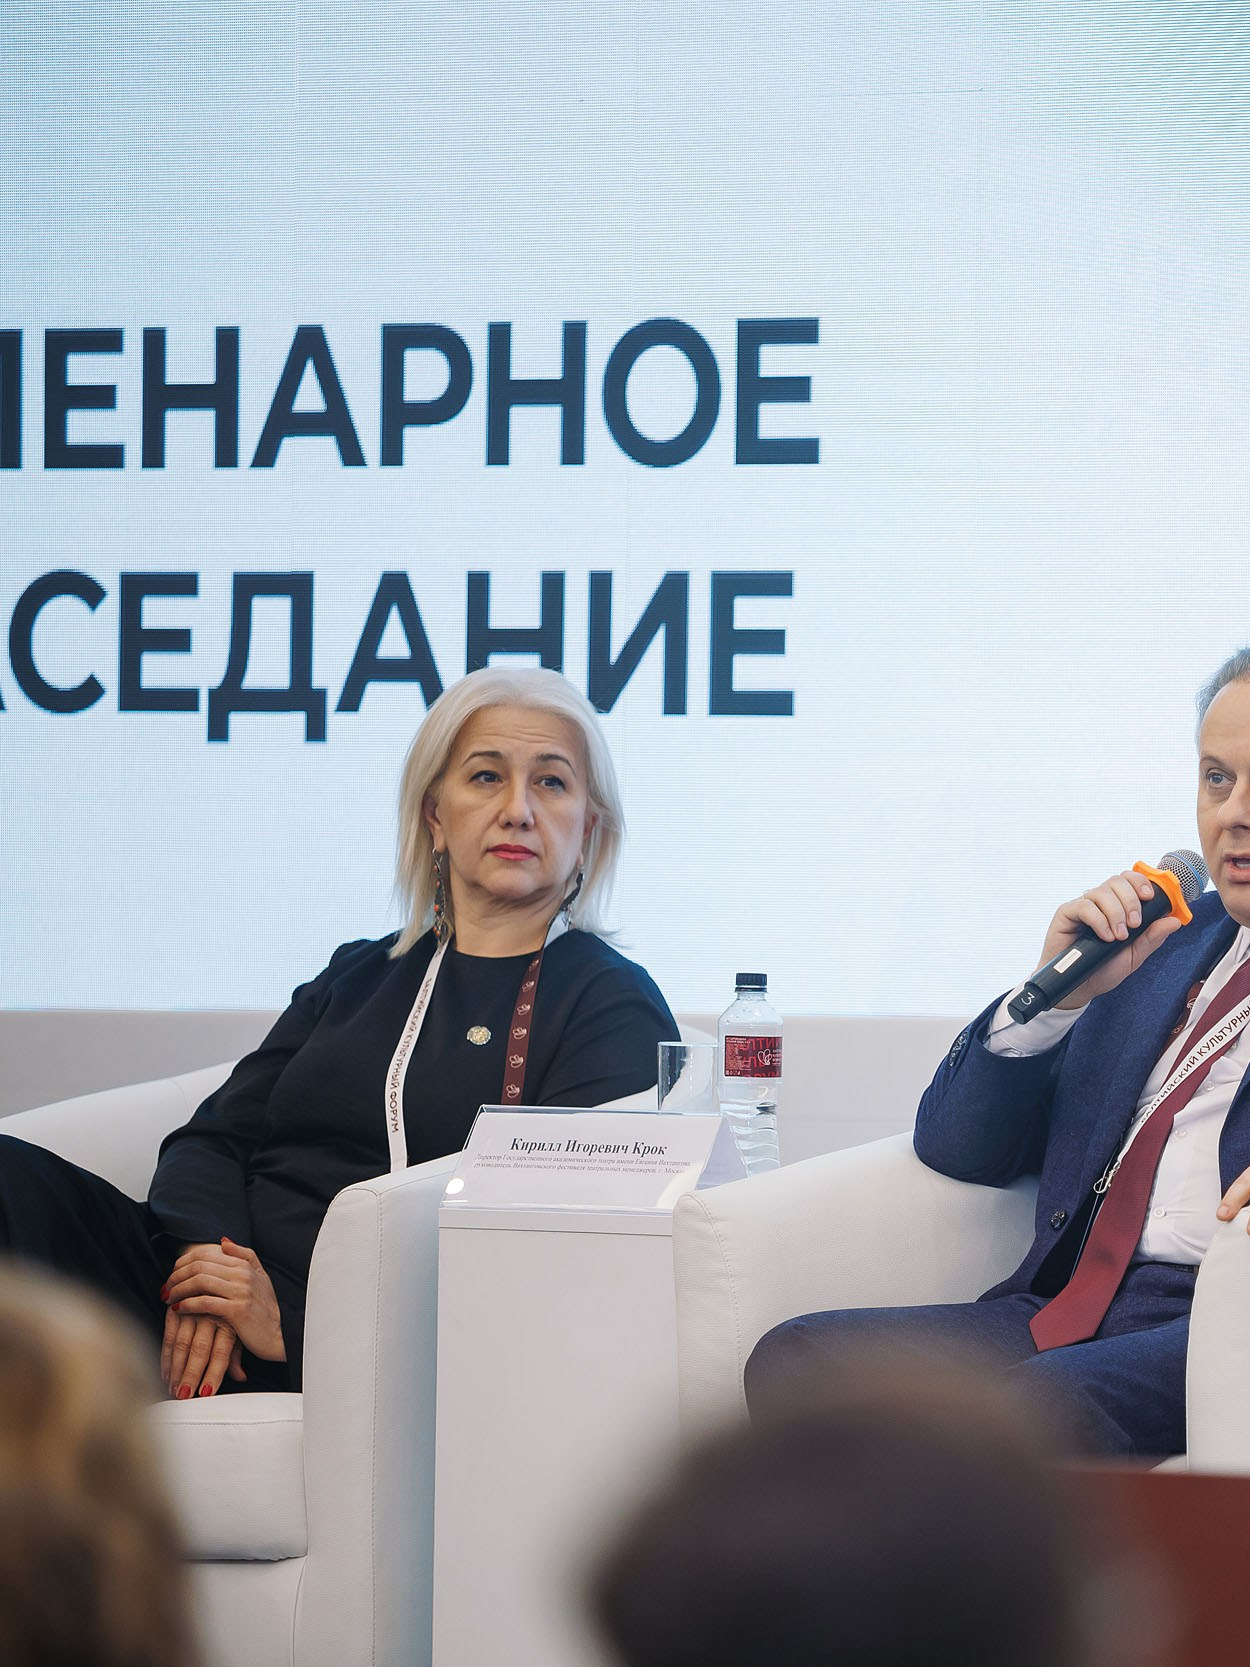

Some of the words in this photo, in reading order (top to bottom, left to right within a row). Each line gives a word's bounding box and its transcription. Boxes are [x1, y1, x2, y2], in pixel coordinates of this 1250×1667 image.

[0, 317, 820, 468] ЕНАРНОЕ
[0, 569, 794, 743] СЕДАНИЕ
[1021, 992, 1035, 1006] 3
[389, 1091, 400, 1133] ФОРУМ
[510, 1138, 562, 1154] Кирилл
[565, 1140, 629, 1156] Игоревич
[632, 1142, 668, 1158] Крок
